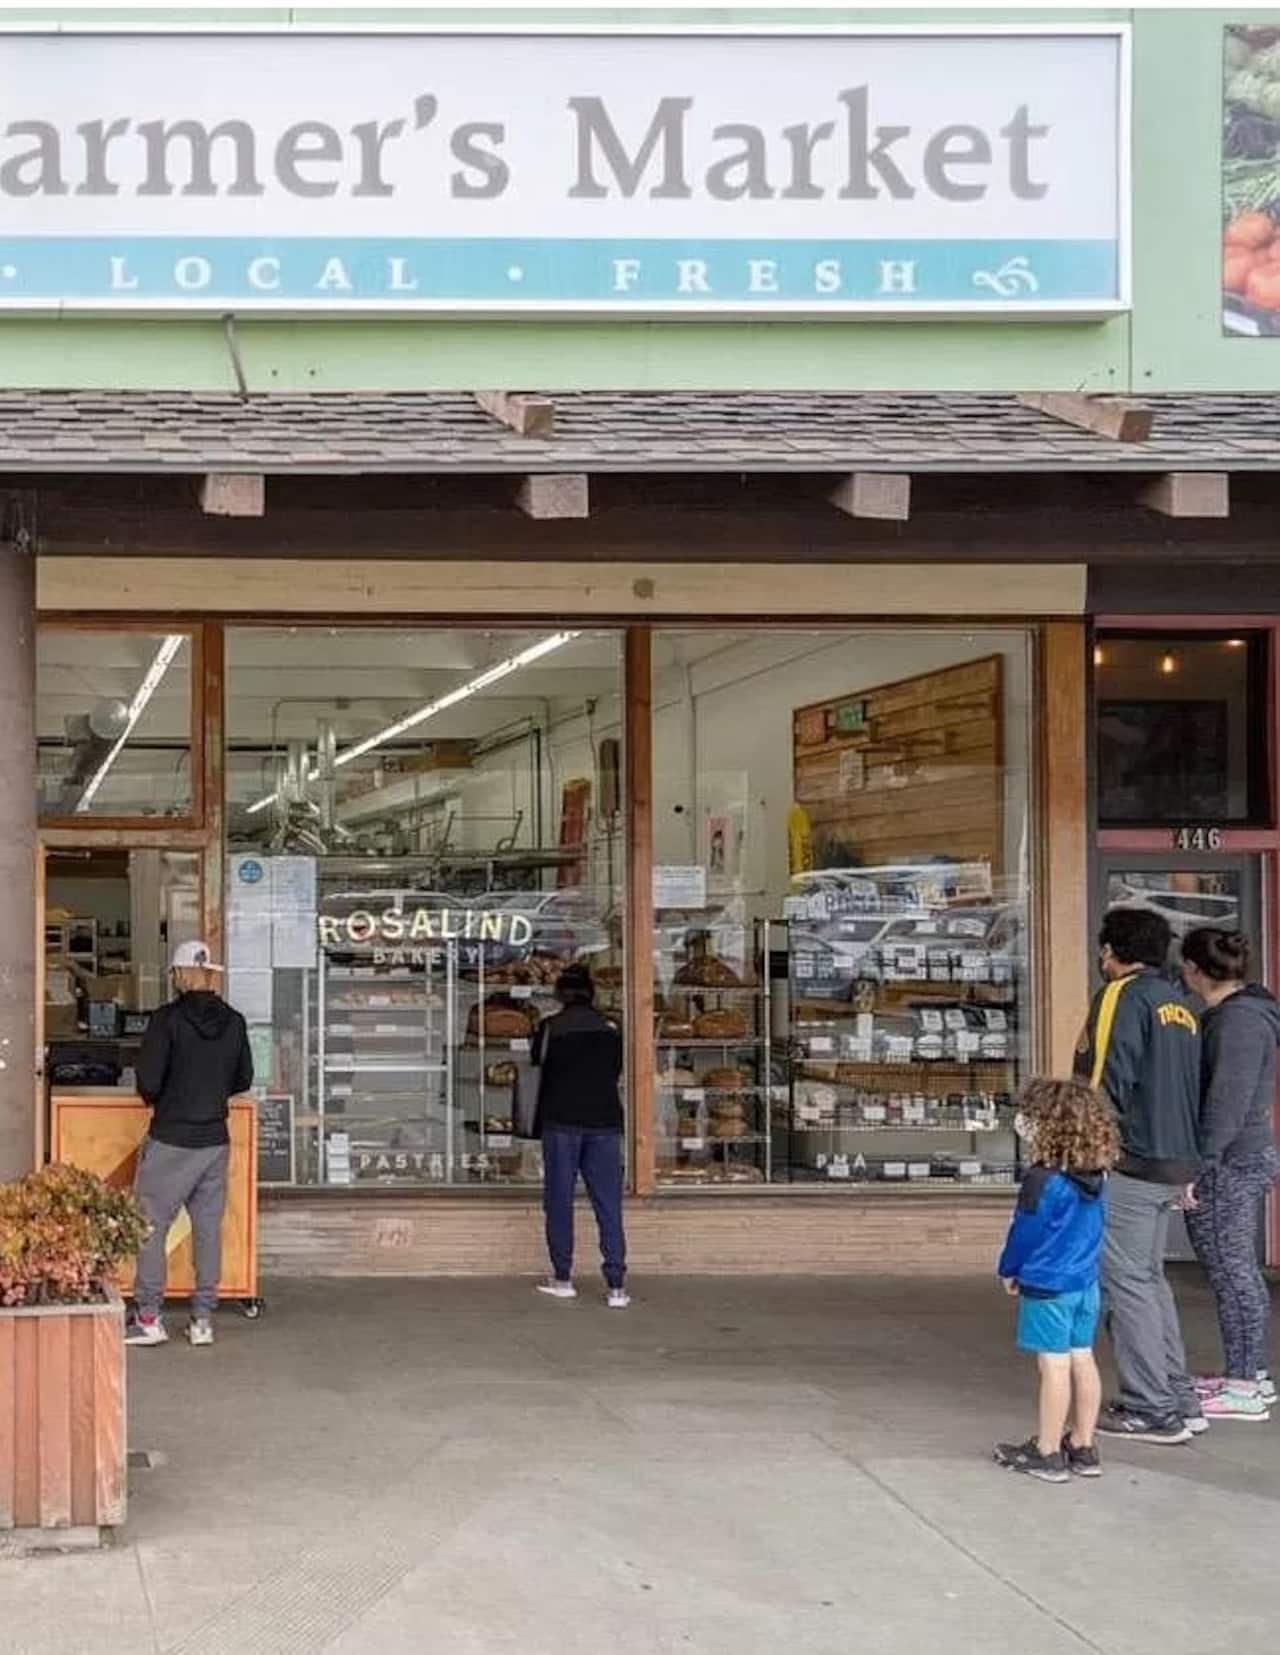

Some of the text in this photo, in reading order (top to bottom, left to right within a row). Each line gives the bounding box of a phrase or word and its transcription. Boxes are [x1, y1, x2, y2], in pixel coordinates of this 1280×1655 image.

[566, 83, 1051, 200] Market
[110, 256, 418, 291] LOCAL
[612, 258, 918, 293] FRESH
[1177, 827, 1222, 850] 446
[319, 907, 533, 947] ROSALIND
[372, 946, 480, 965] BAKERY
